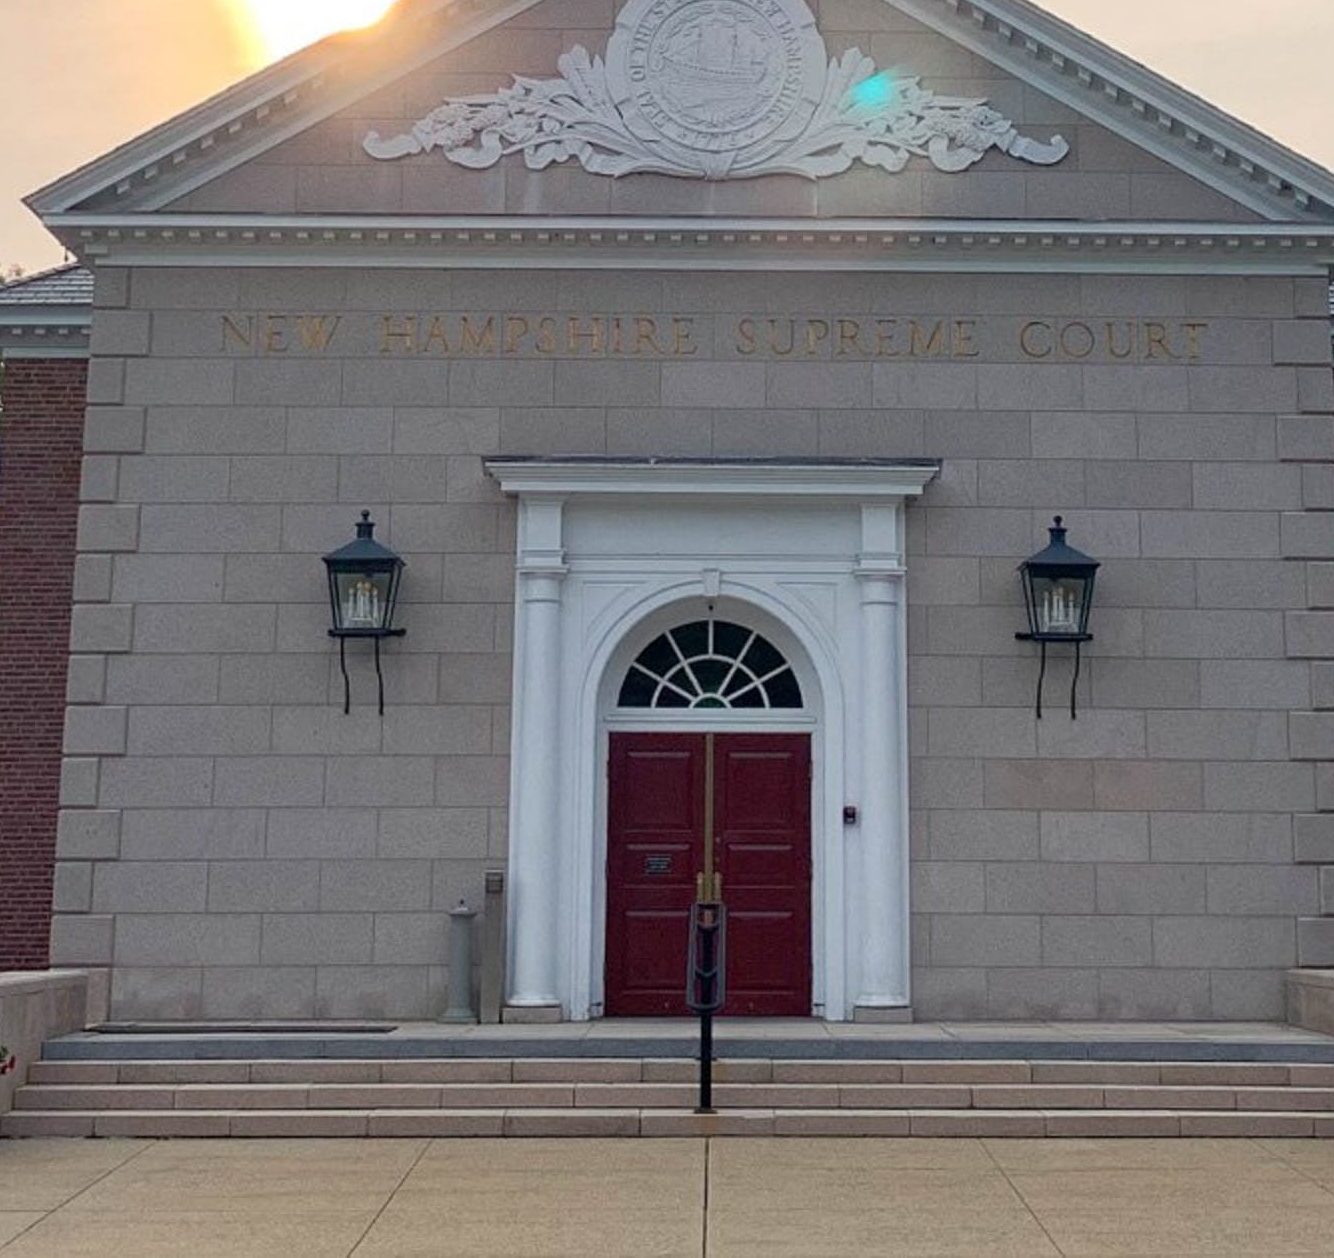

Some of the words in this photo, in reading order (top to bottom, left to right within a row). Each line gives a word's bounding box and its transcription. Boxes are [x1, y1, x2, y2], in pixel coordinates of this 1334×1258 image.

[218, 315, 342, 353] NEW
[377, 316, 698, 355] HAMPSHIRE
[736, 319, 980, 356] SUPREME
[1020, 321, 1209, 359] COURT
